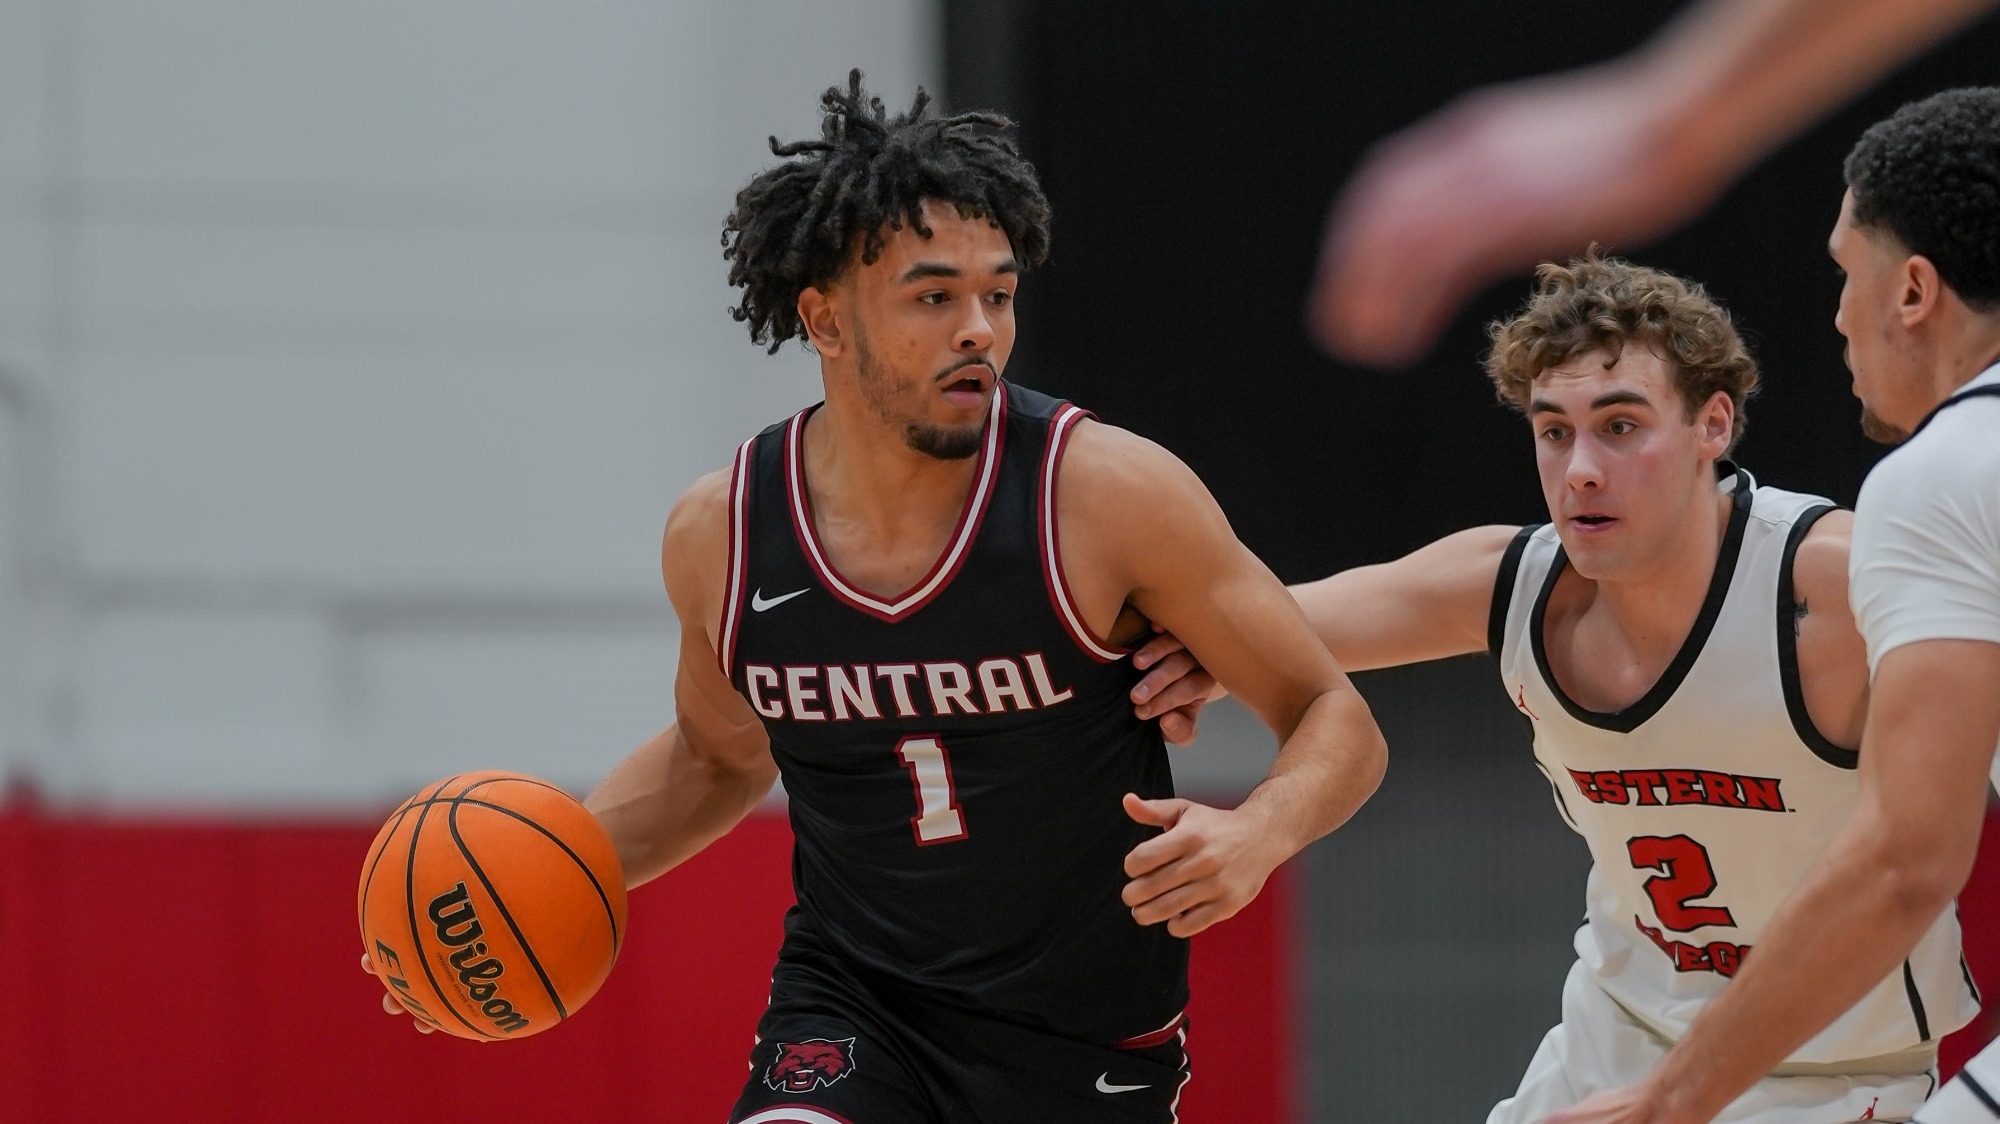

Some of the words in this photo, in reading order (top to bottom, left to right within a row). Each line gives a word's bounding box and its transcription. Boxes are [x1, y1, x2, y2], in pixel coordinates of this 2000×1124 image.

[745, 652, 1075, 721] CENTRAL
[894, 734, 969, 847] 1
[1565, 767, 1787, 812] ESTERN
[1626, 834, 1738, 933] 2
[428, 880, 531, 1034] Wilson
